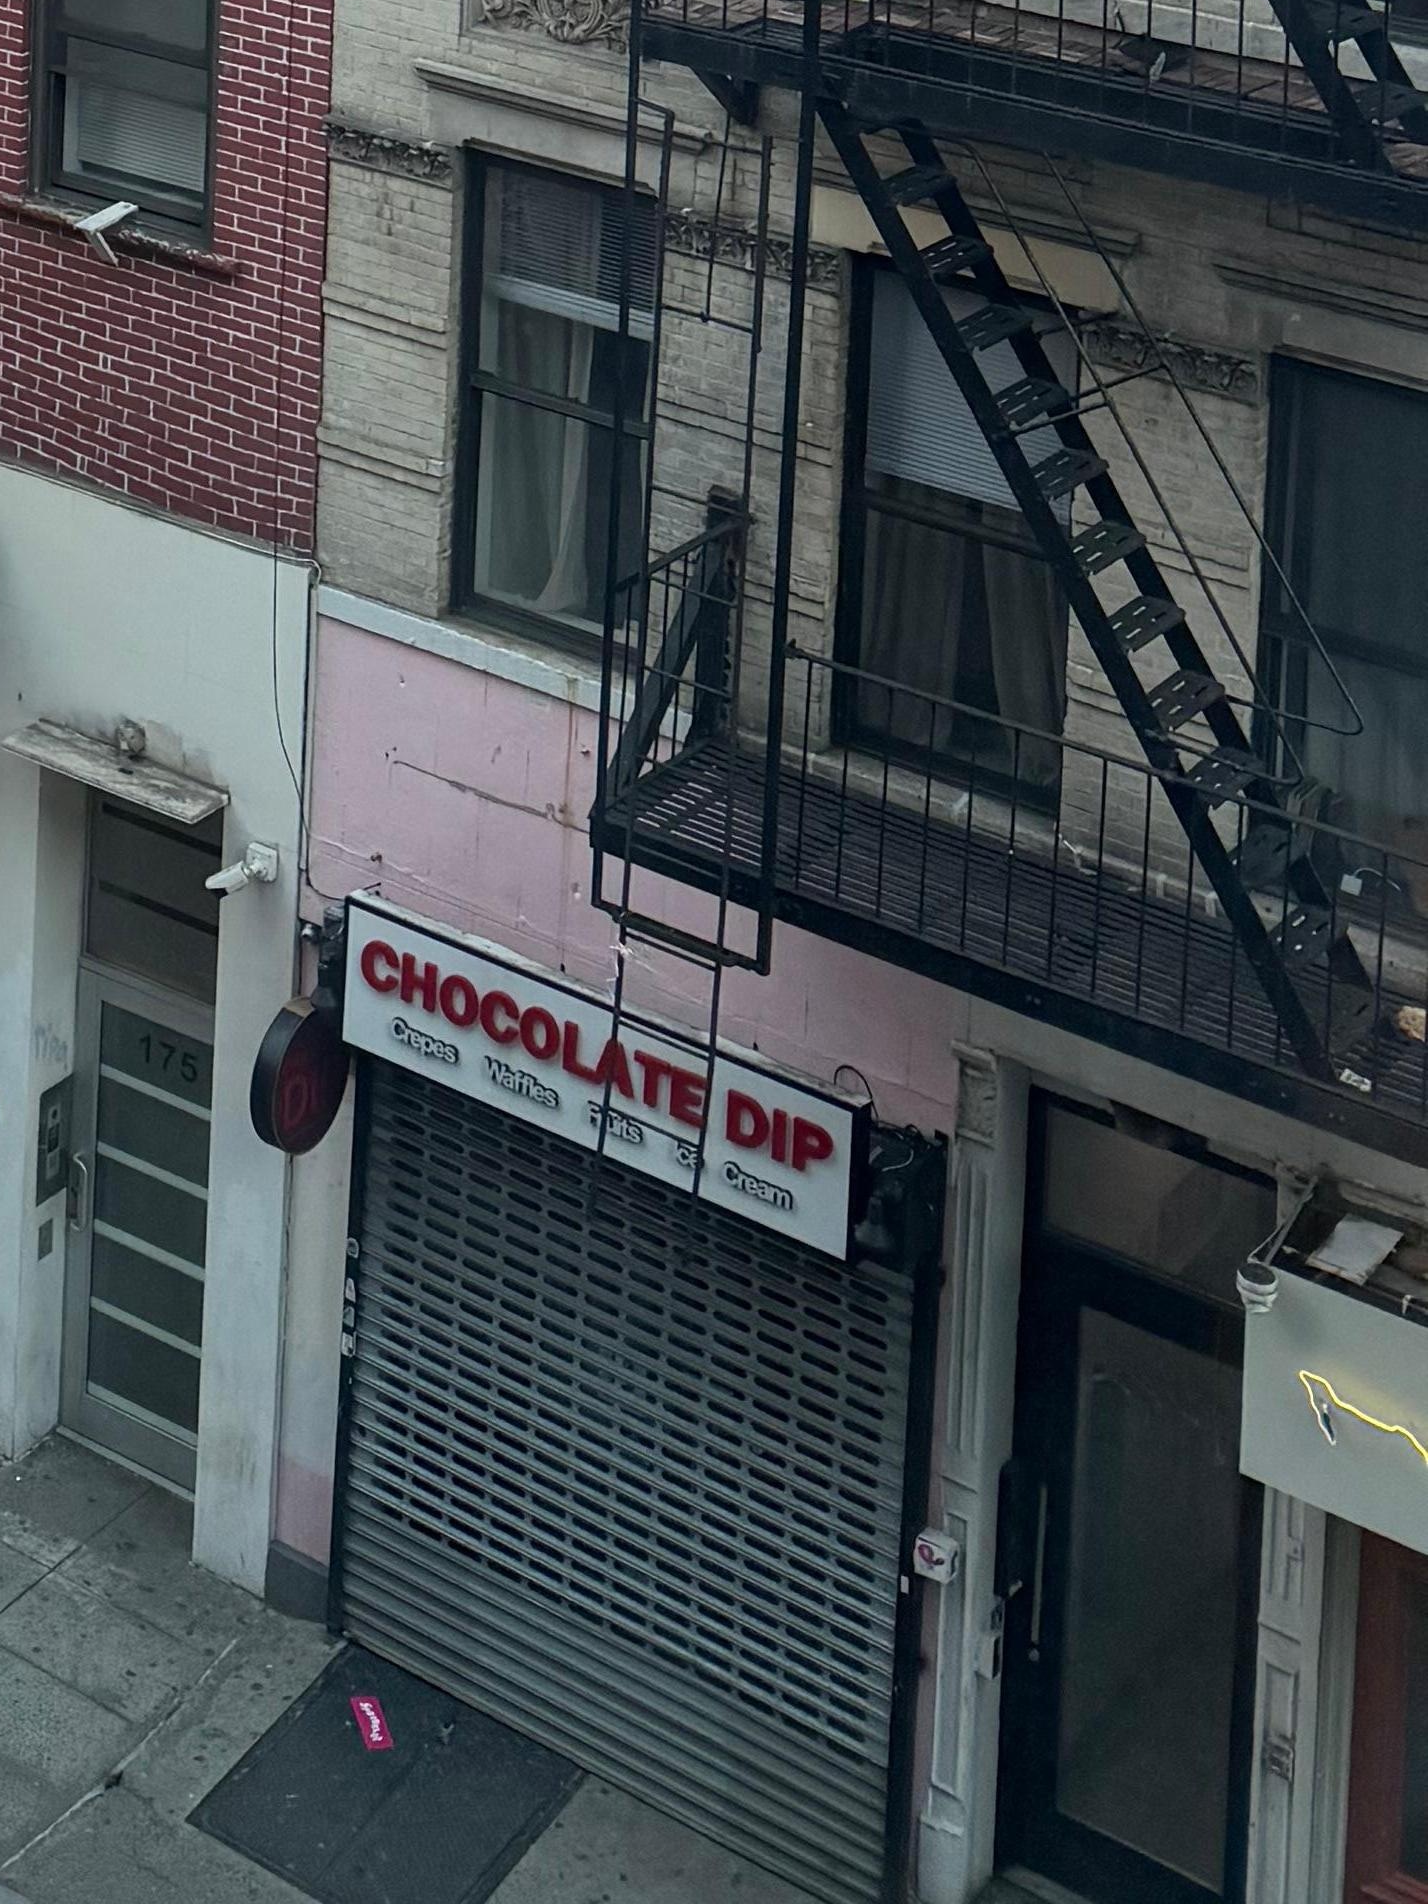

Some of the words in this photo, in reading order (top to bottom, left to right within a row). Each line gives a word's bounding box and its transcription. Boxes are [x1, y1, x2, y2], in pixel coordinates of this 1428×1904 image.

[141, 1033, 199, 1083] 175
[360, 939, 708, 1130] CHOCOLATE
[725, 1088, 834, 1173] DIP
[391, 1016, 460, 1065] Crepes
[484, 1055, 560, 1109] Waffles
[723, 1160, 794, 1211] Cream
